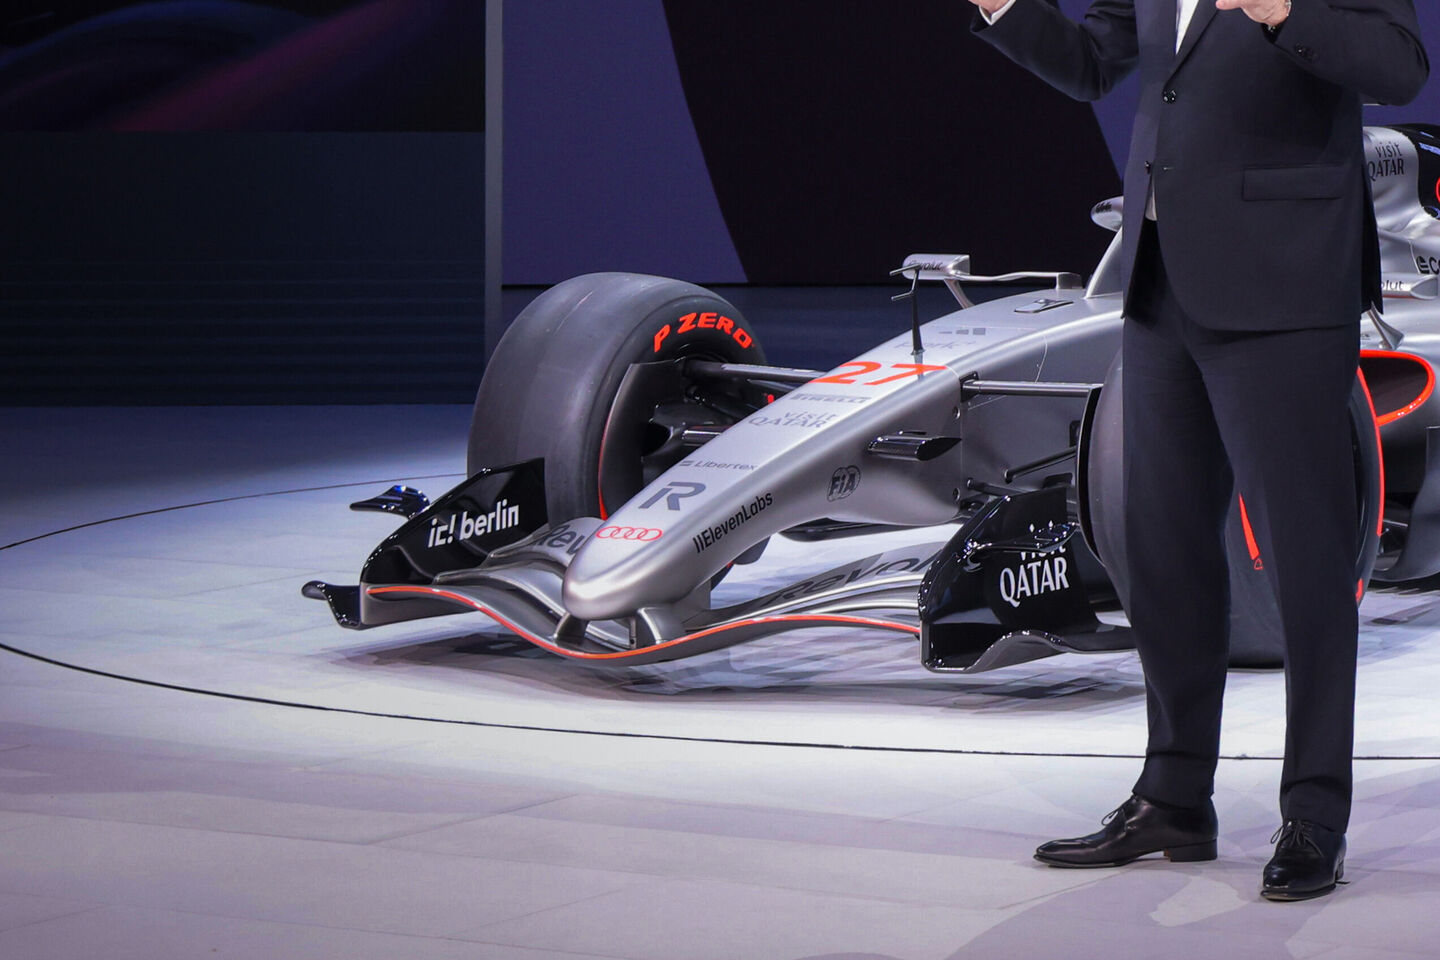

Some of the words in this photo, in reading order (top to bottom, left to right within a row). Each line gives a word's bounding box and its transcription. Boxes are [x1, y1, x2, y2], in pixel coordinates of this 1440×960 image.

[1375, 141, 1402, 158] visit
[1367, 158, 1404, 181] QATAR
[654, 324, 671, 353] P
[677, 312, 753, 349] ZERO
[807, 361, 948, 386] 27
[748, 416, 827, 429] QATAR
[694, 460, 760, 471] Libertex
[638, 481, 706, 511] R
[459, 499, 519, 541] berlin
[1000, 556, 1069, 608] QATAR
